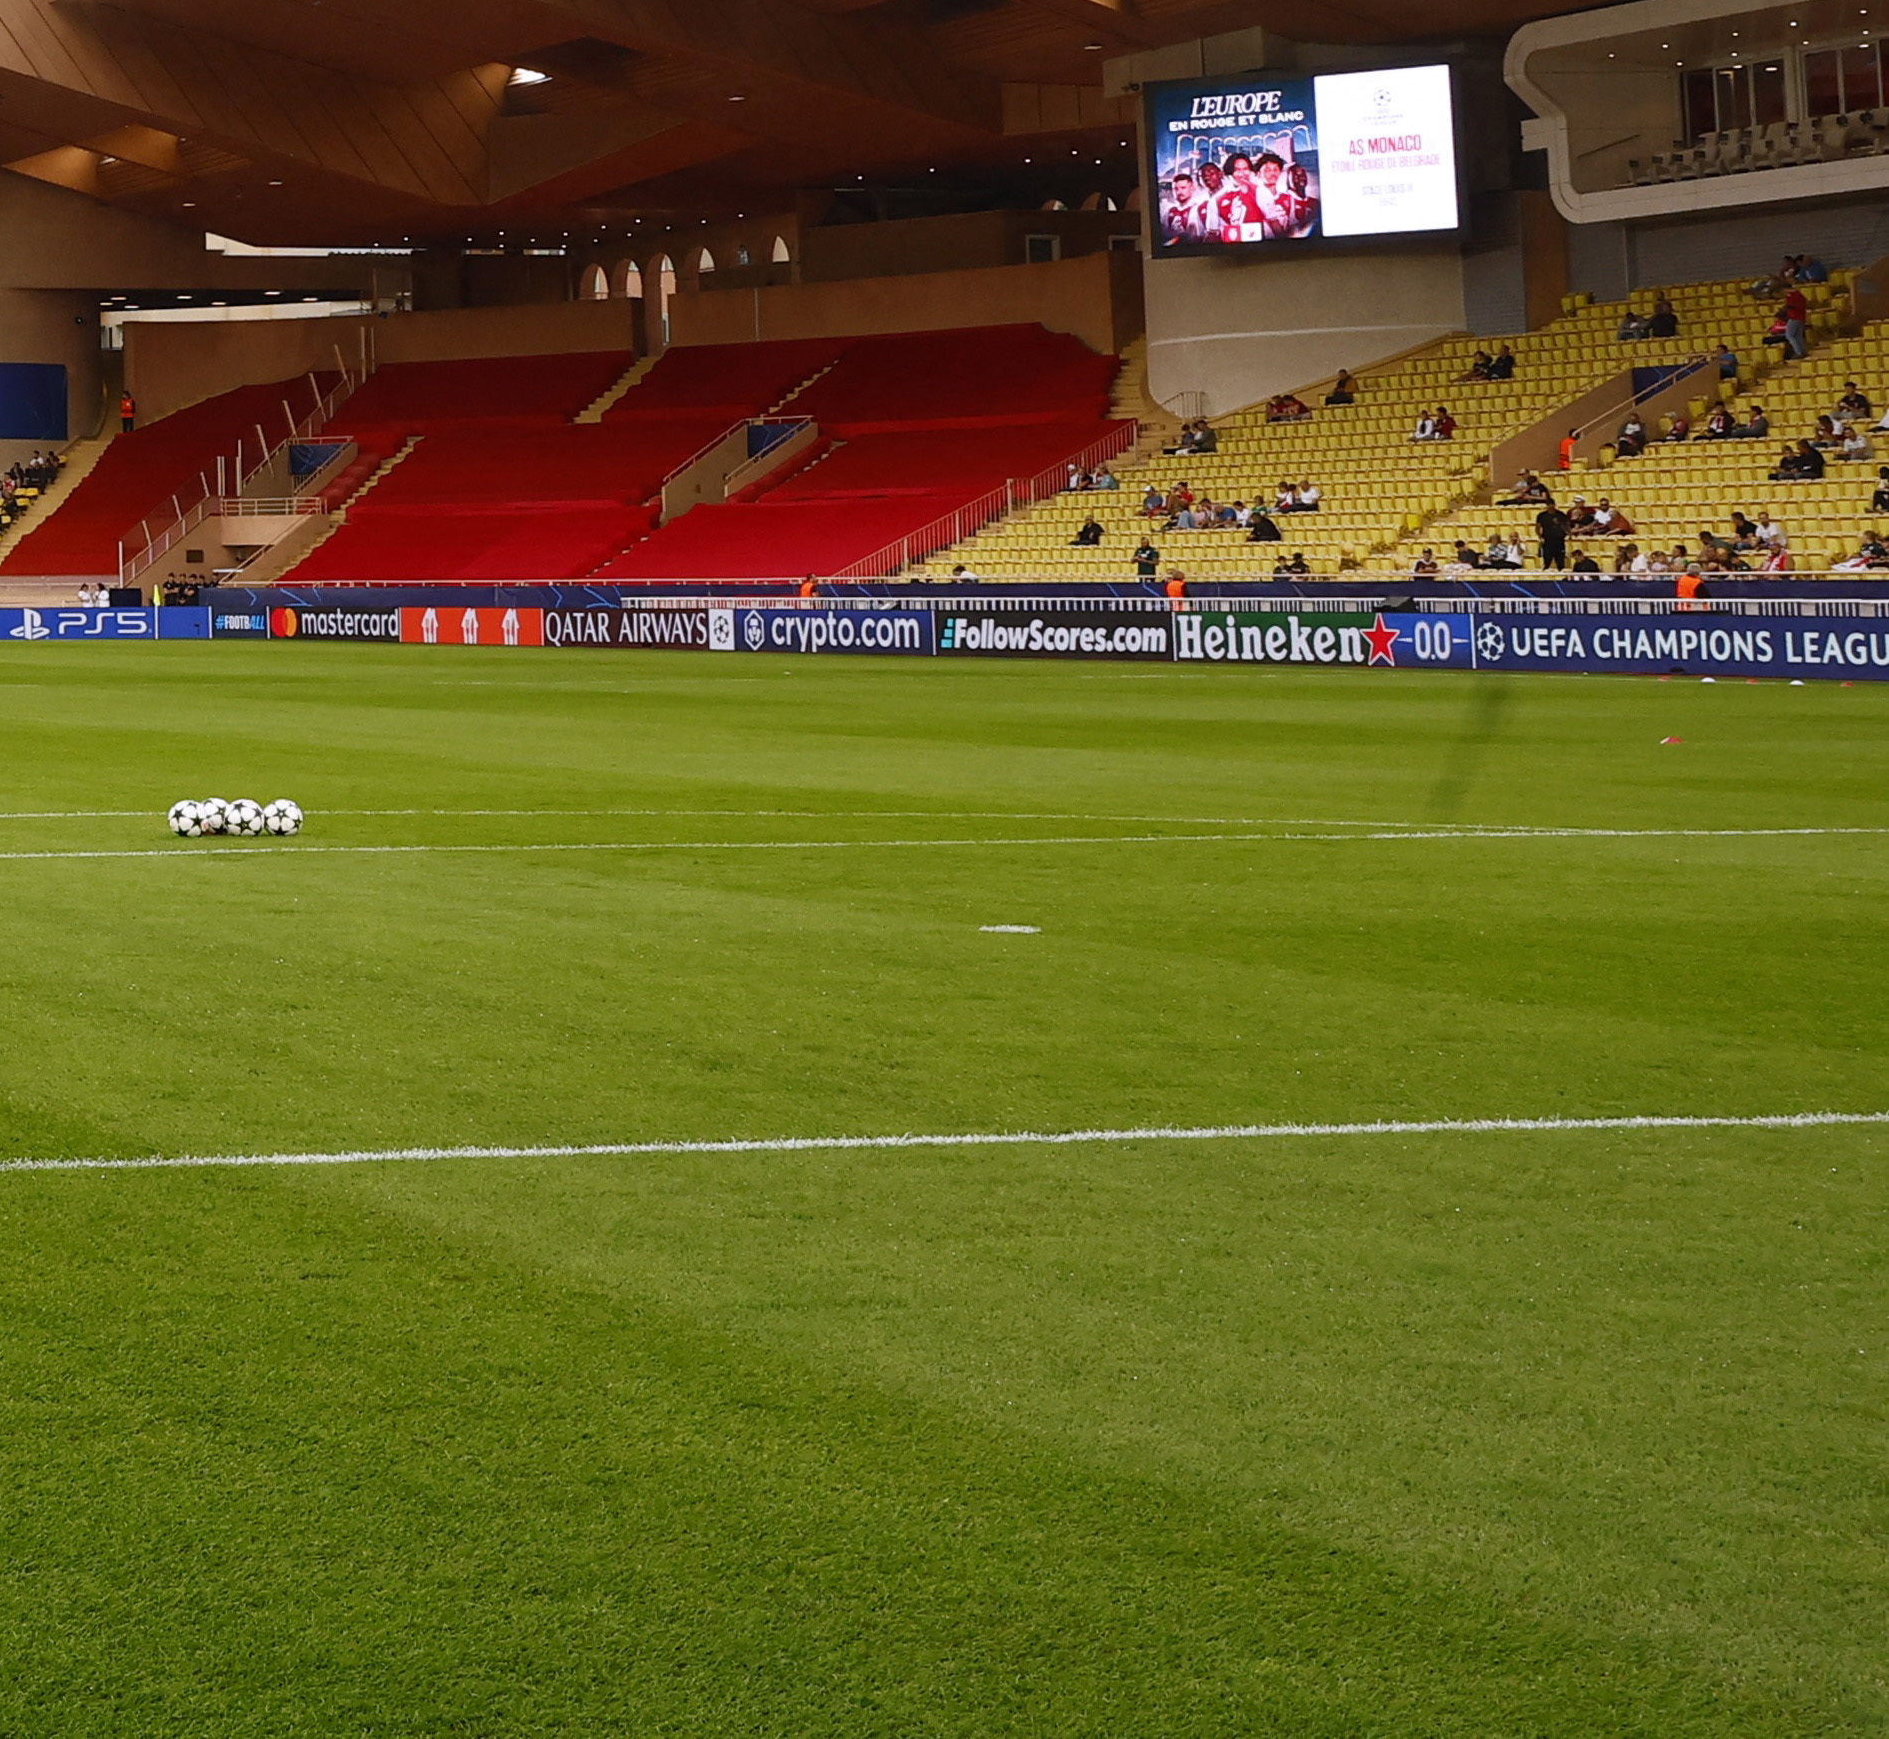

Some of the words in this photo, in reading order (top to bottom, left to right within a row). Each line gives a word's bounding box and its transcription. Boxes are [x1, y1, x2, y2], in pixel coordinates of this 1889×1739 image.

[1190, 91, 1282, 118] L'EUROPE
[1169, 121, 1188, 132] EN
[1190, 117, 1236, 129] ROUGE
[1238, 115, 1255, 126] ET
[1259, 110, 1305, 124] BLANC
[1349, 139, 1364, 155] AS
[1368, 134, 1422, 153] MONACO
[58, 612, 148, 634] PS5
[215, 615, 265, 630] #FOOTBALL
[301, 607, 399, 636] mastercard
[545, 612, 611, 647] QATAR
[618, 612, 708, 644] AIRWAYS
[772, 611, 920, 653] crypto.com
[954, 618, 1167, 652] FollowScores.com
[1177, 614, 1364, 662] Heineken
[1511, 628, 1586, 658] UEFA
[1593, 628, 1773, 663] CHAMPIONS
